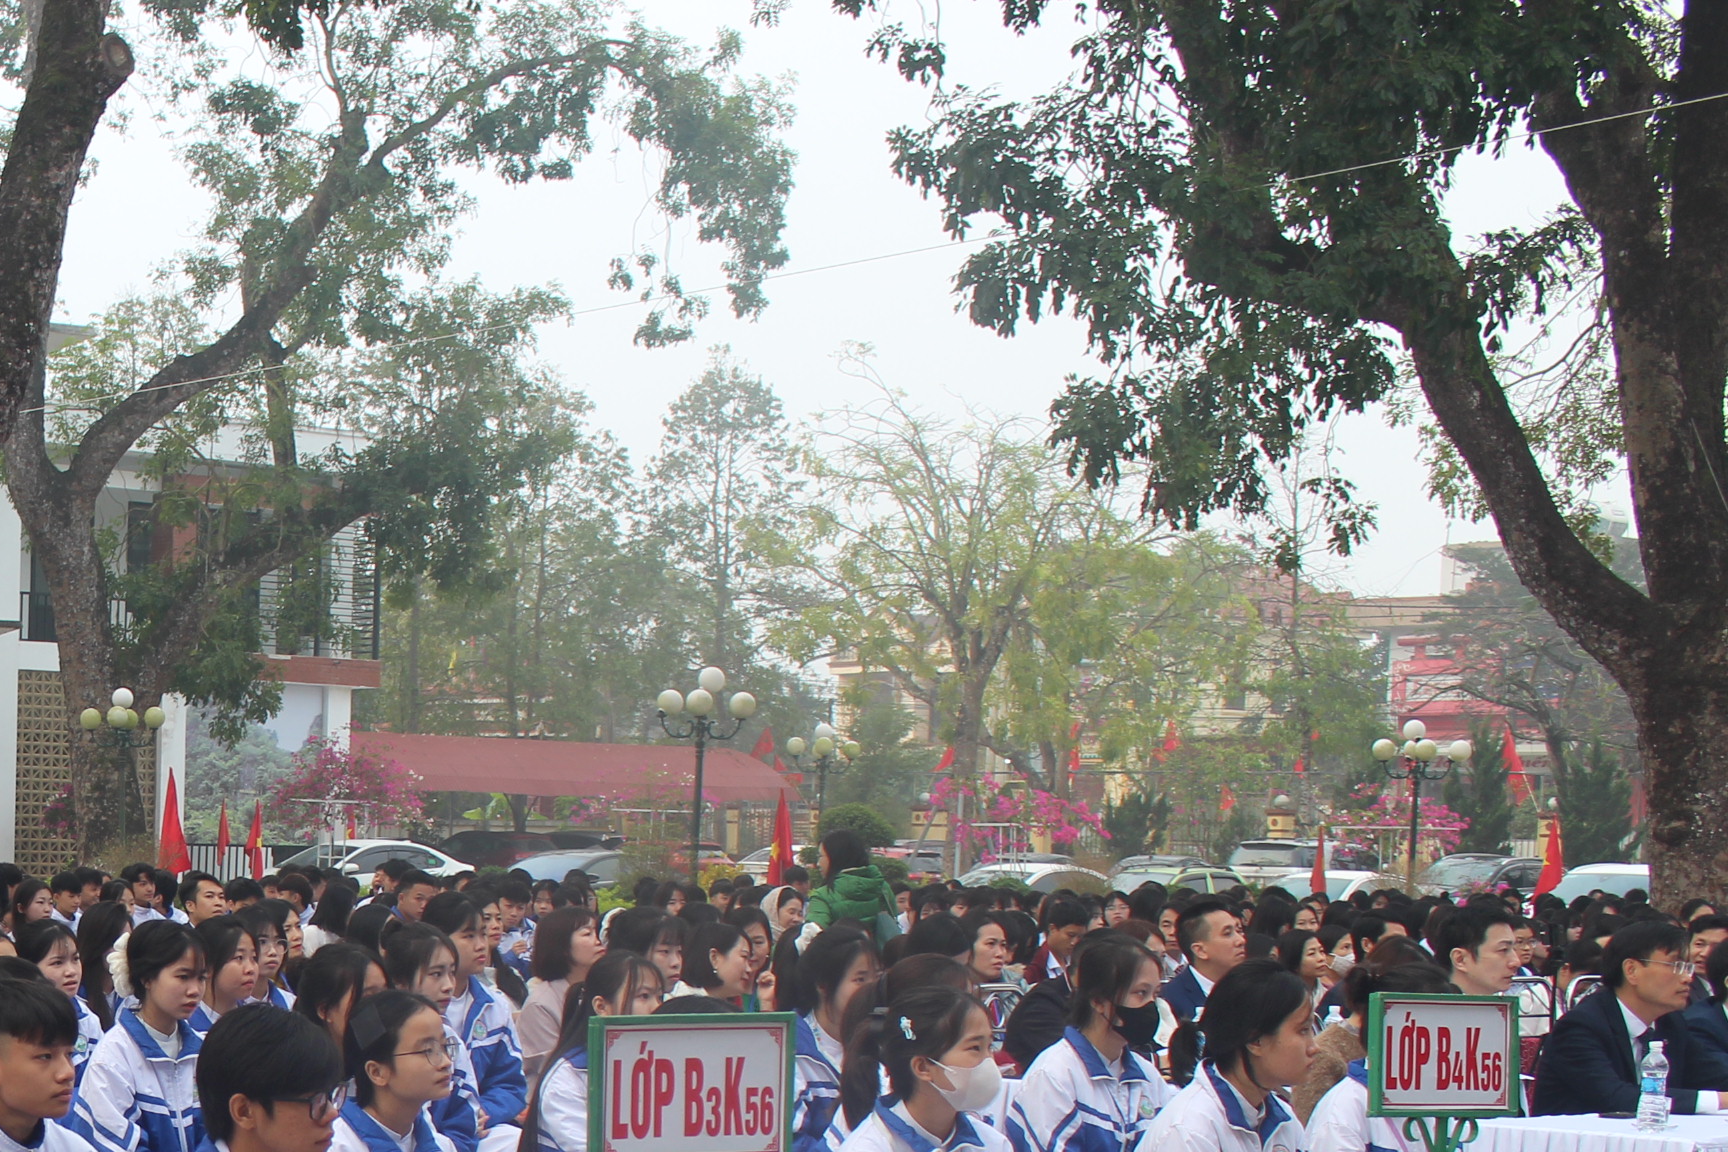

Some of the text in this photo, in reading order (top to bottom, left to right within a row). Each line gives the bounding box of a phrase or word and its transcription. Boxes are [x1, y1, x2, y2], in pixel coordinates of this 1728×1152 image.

[611, 1040, 774, 1140] LỚP B3K56
[1385, 1011, 1502, 1092] LỚP B4K56
